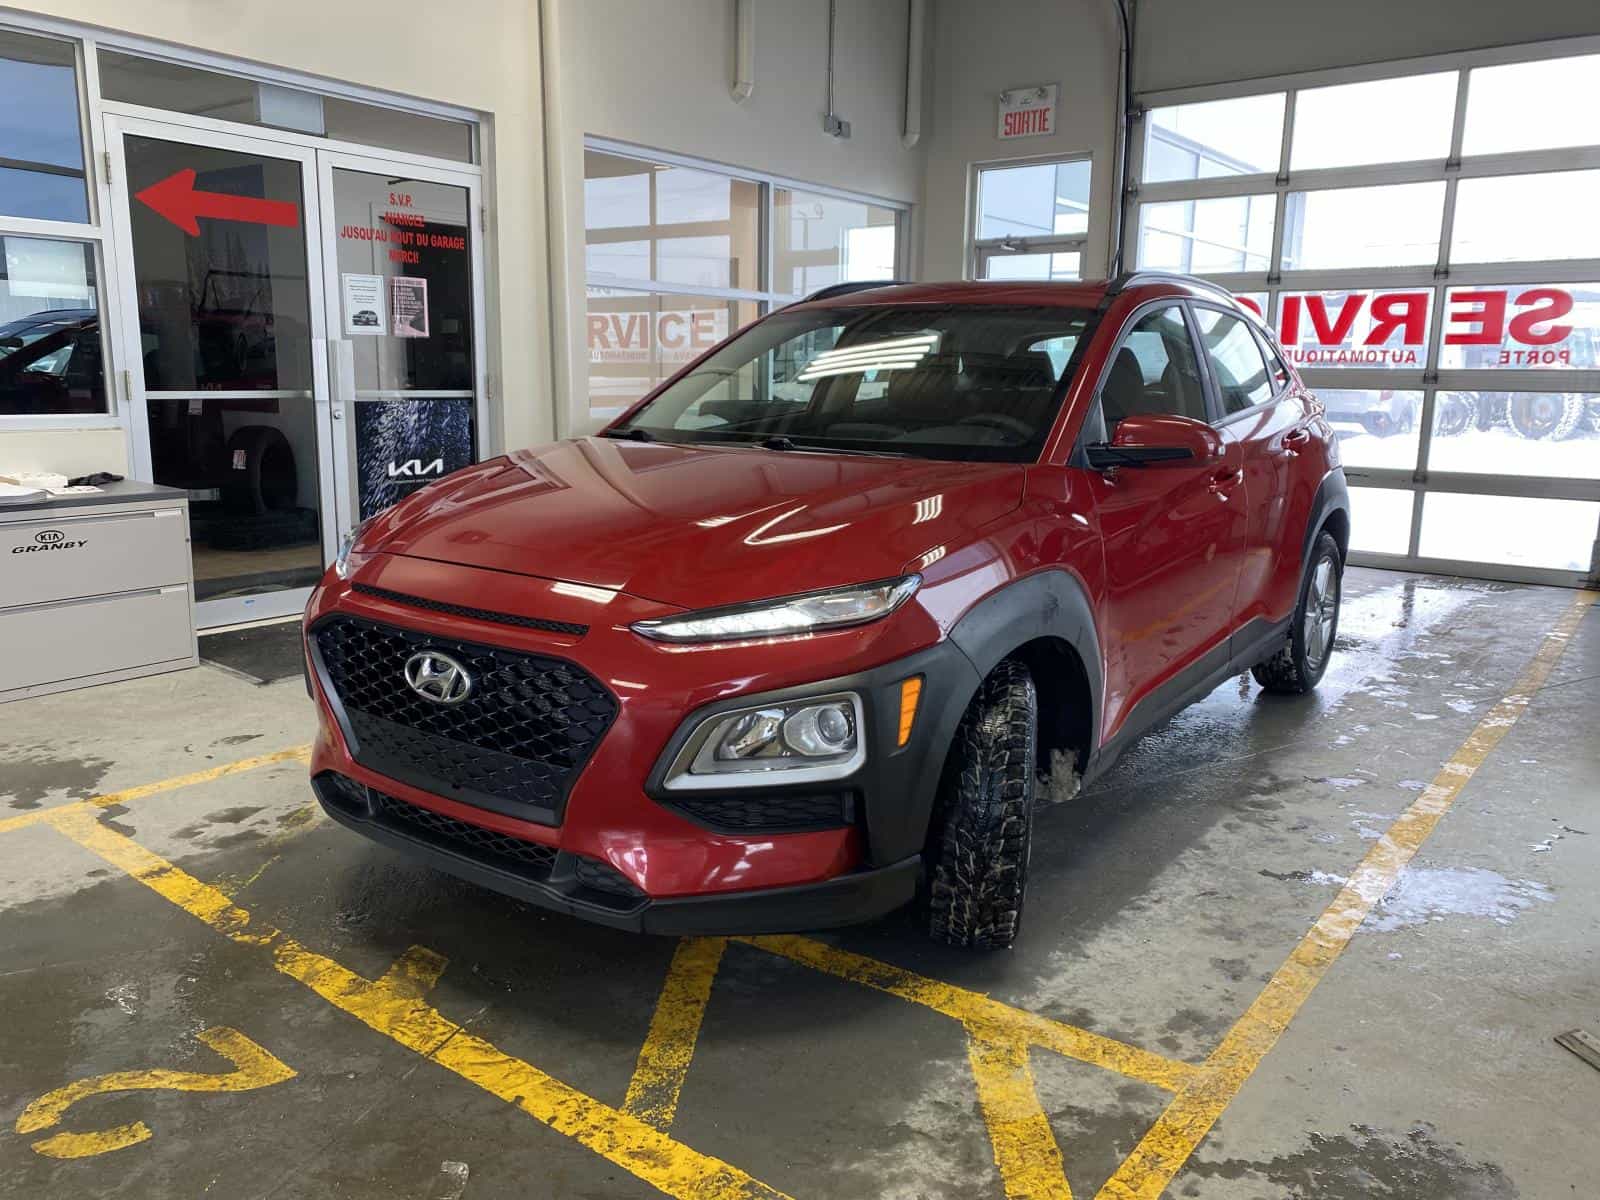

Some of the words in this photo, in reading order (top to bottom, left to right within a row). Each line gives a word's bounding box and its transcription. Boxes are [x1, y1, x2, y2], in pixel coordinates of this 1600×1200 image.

[1004, 107, 1050, 136] SORTIE
[340, 225, 387, 242] JUSQU'AU
[416, 233, 429, 246] DU
[431, 235, 465, 250] GARAGE
[388, 458, 444, 477] KIA
[12, 540, 88, 553] GRANBY
